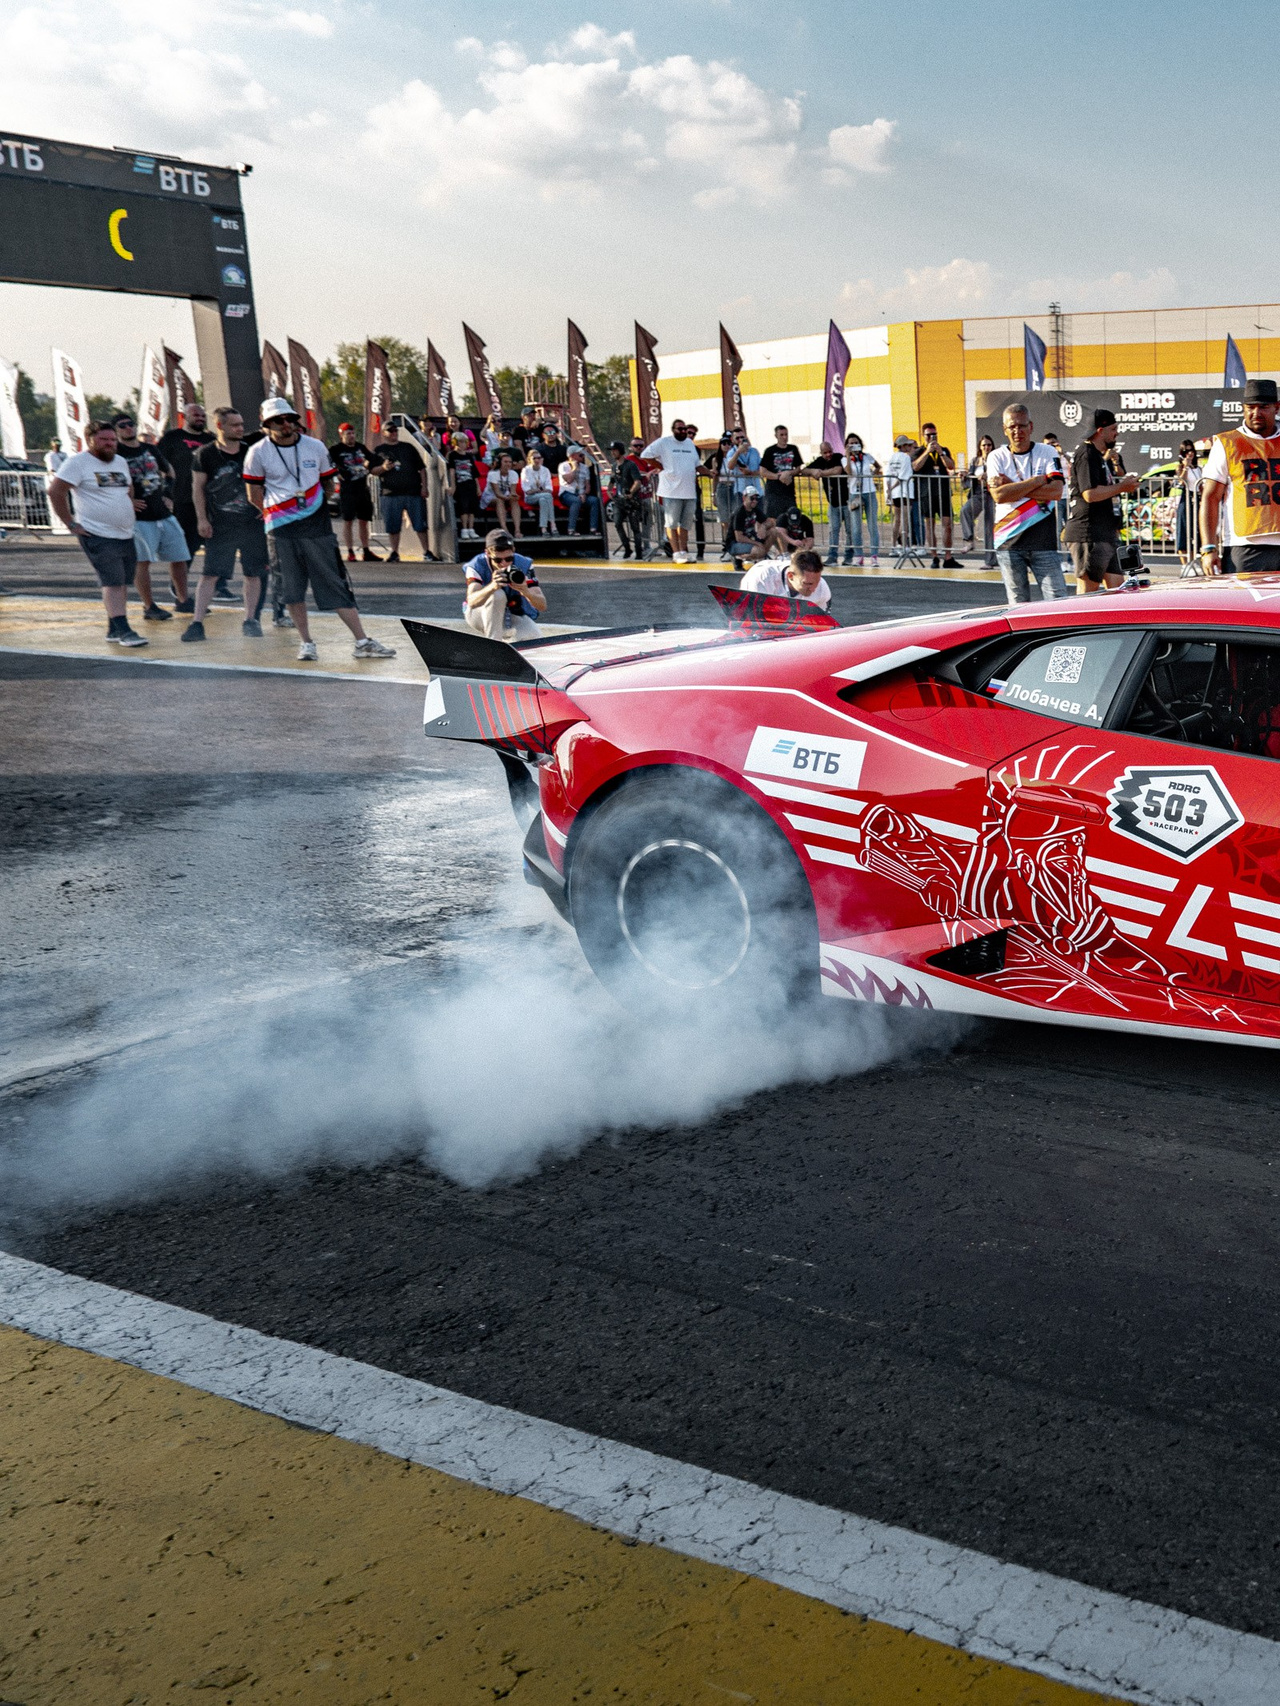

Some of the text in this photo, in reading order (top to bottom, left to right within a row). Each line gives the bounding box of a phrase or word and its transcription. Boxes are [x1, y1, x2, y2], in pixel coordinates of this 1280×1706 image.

[158, 165, 211, 197] ВТБ
[221, 219, 240, 231] ВТБ
[1120, 392, 1176, 409] RDRC
[1222, 401, 1244, 413] ВТБ
[1158, 412, 1198, 422] РОССИИ
[1117, 420, 1196, 433] ДРЭГ-РЕЙСИНГУ
[1150, 447, 1173, 460] ВТБ
[1006, 683, 1103, 721] Лобачев А.
[792, 747, 841, 775] ВТБ
[1168, 781, 1201, 794] RDRC
[1142, 789, 1208, 827] 503
[1153, 821, 1195, 835] RACEPARK
